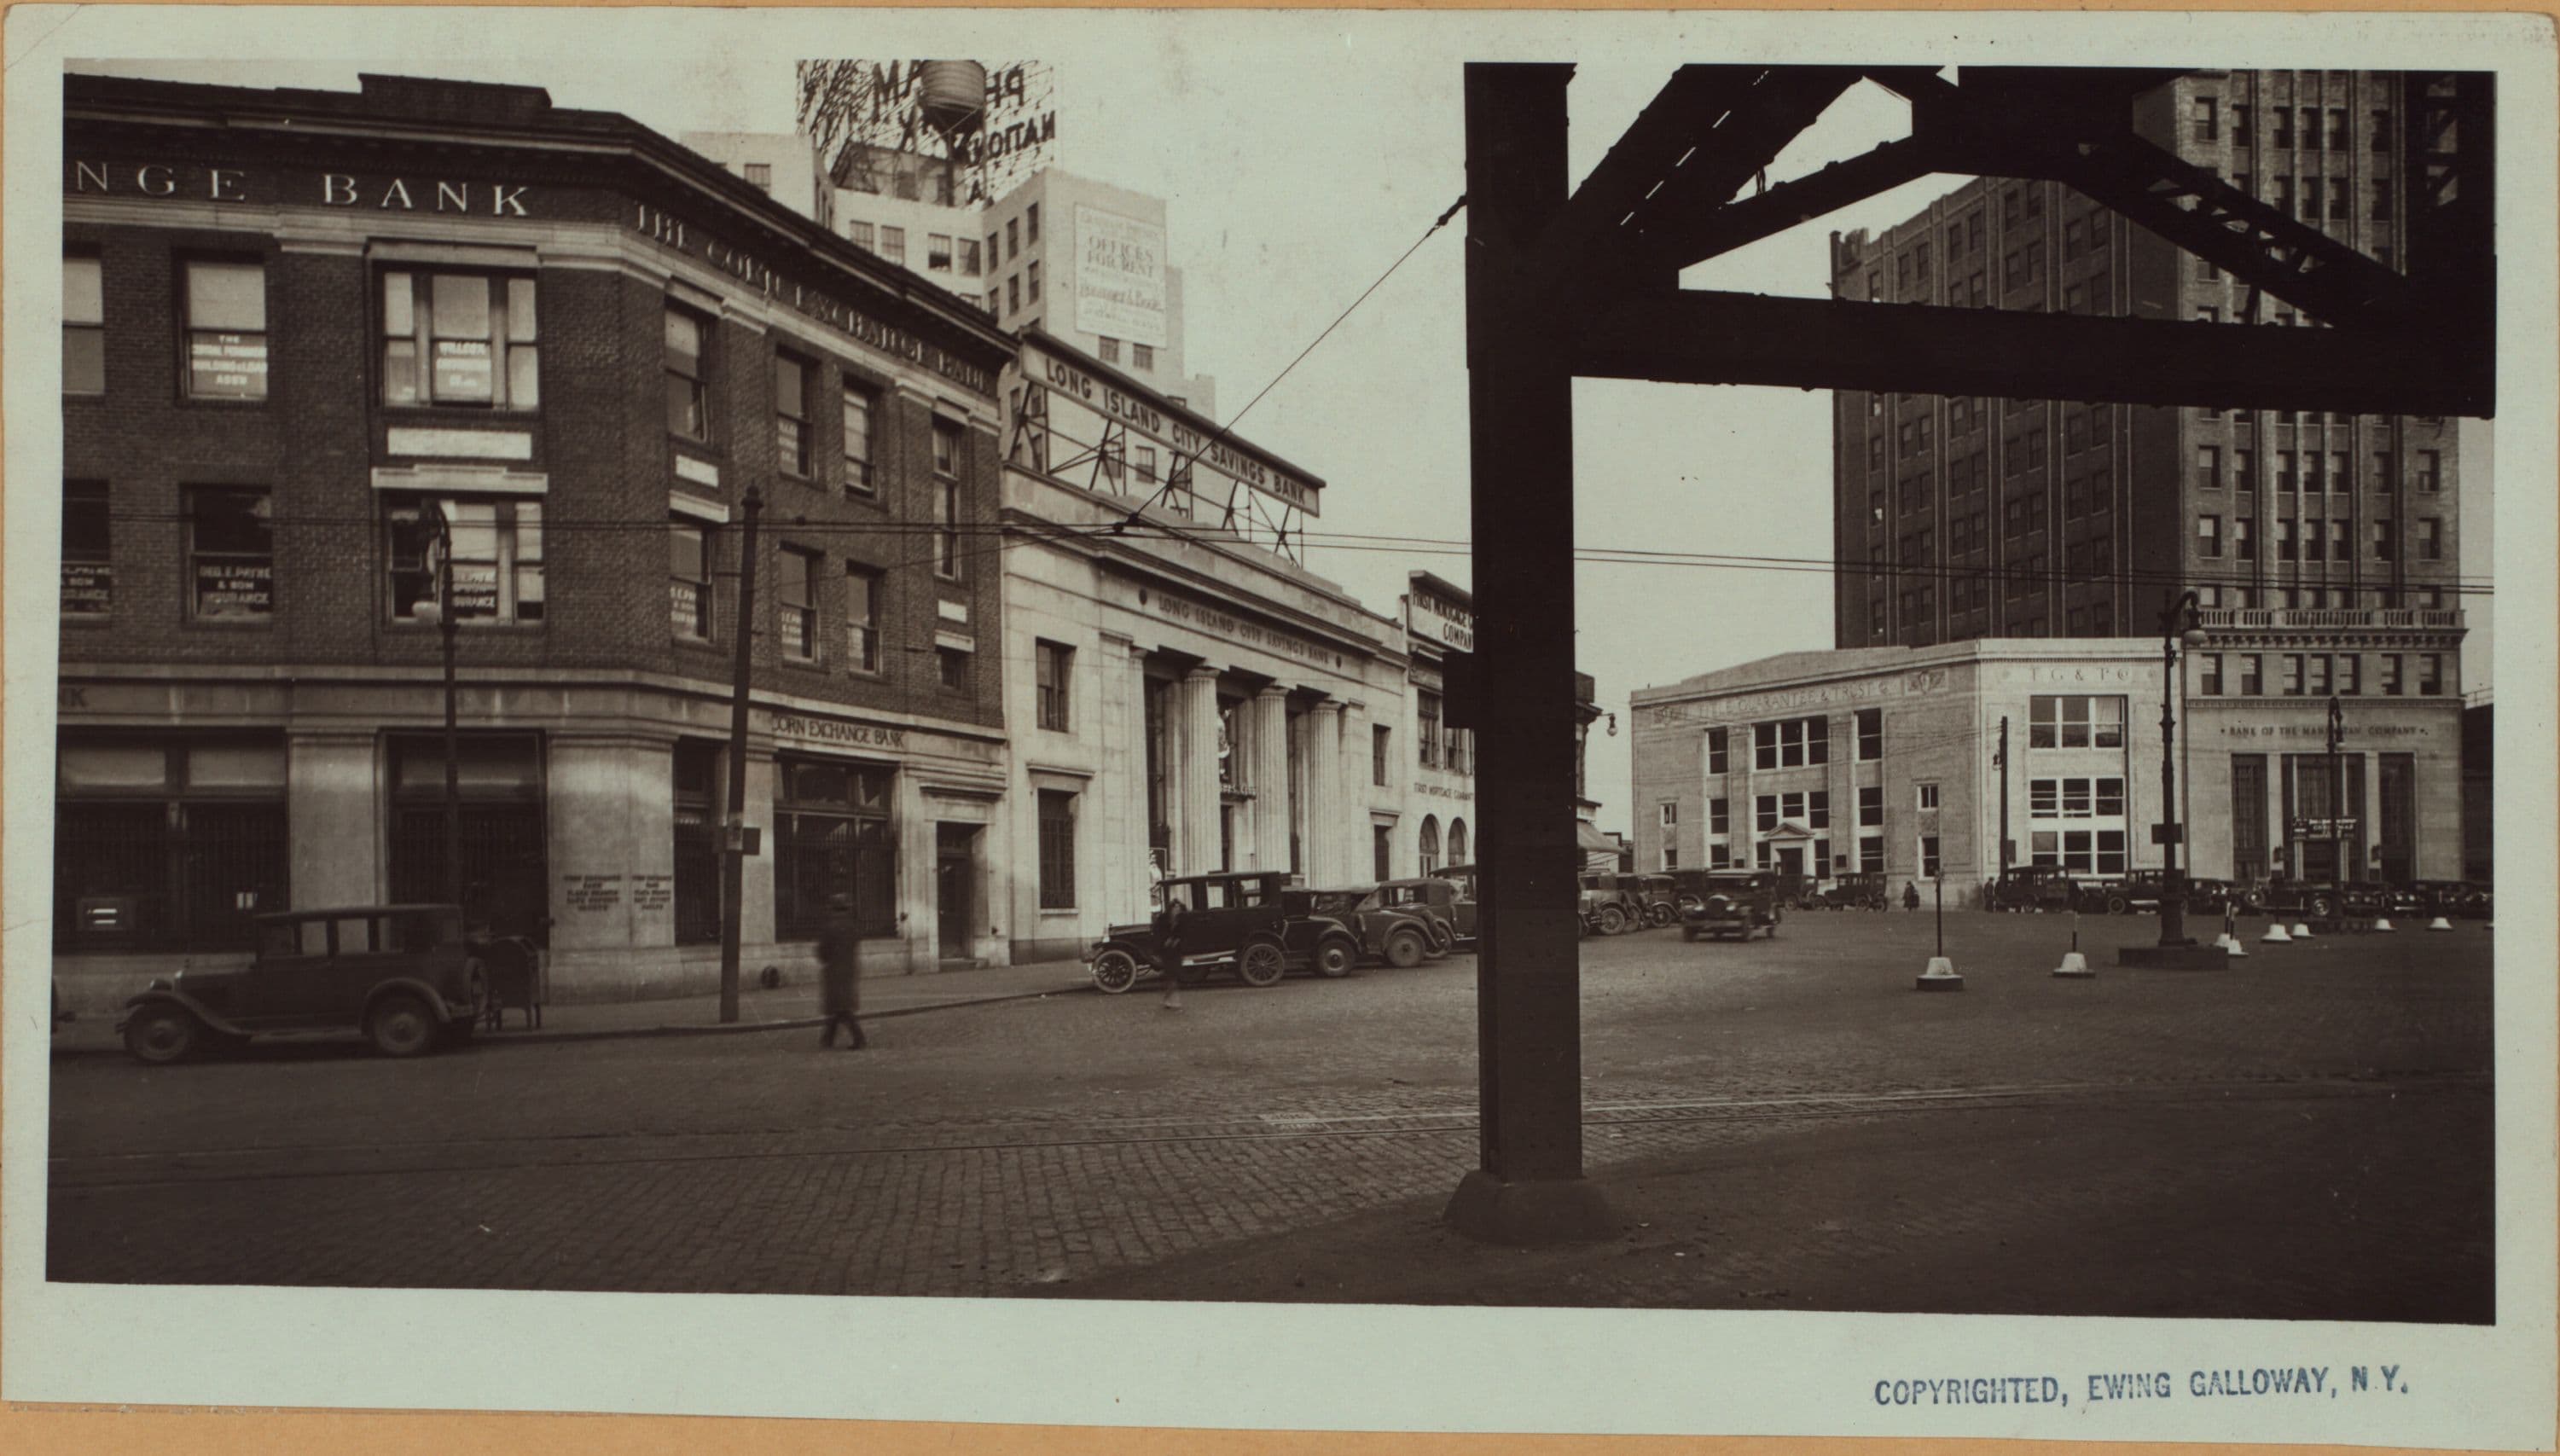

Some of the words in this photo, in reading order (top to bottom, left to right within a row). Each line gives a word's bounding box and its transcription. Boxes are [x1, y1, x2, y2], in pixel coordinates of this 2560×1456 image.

[76, 160, 246, 201] NGE
[323, 173, 531, 217] BANK
[1046, 357, 1091, 399] LONG
[1104, 388, 1160, 433] ISLAND
[1173, 424, 1200, 452] CITY
[1210, 443, 1265, 485] SAVINGS
[1274, 474, 1304, 504] BANK
[1158, 595, 1189, 619] LONG
[1195, 609, 1234, 633] ISLAND
[1239, 624, 1262, 642] CITY
[1267, 633, 1303, 656] SAVINGS
[1443, 623, 1473, 650] COMPAN
[771, 716, 805, 734] CORN
[810, 720, 870, 744] EXCHANGE
[874, 729, 904, 747] BANK
[2229, 726, 2255, 737] BANK
[2261, 727, 2274, 737] OF
[2279, 727, 2298, 737] THE
[2368, 726, 2417, 738] COMPANY
